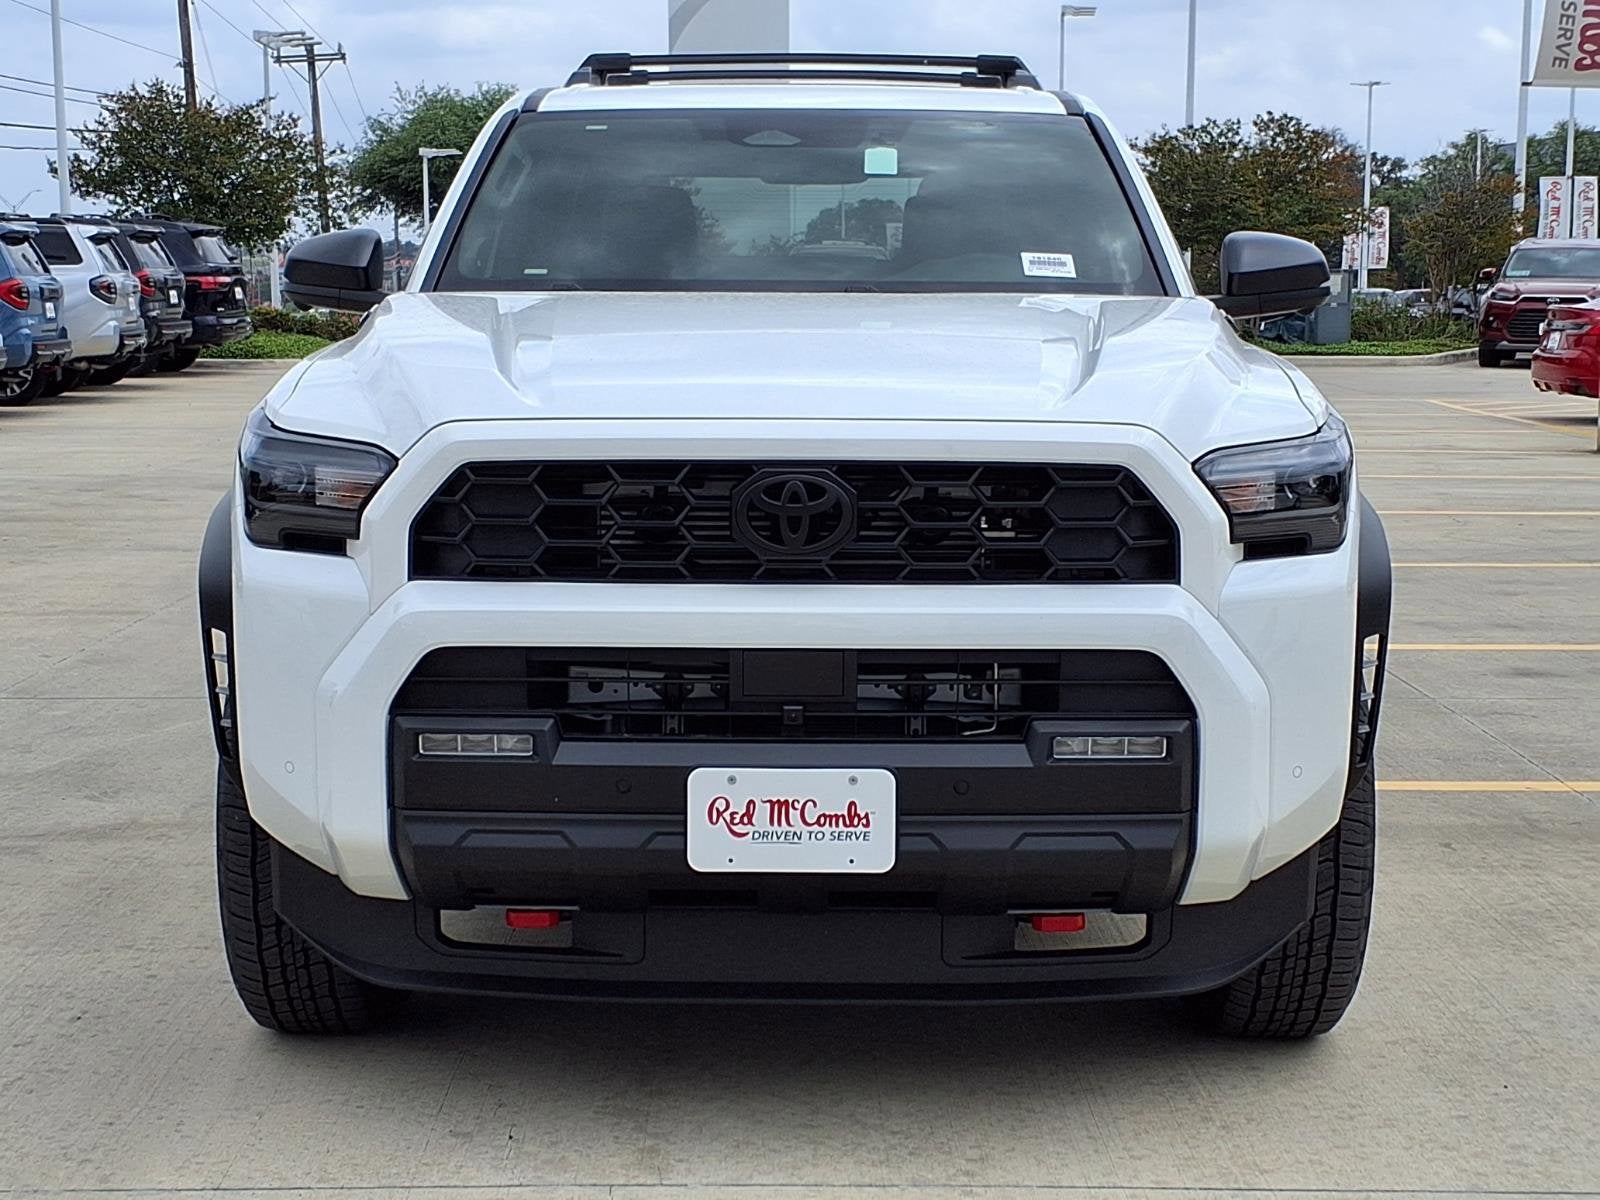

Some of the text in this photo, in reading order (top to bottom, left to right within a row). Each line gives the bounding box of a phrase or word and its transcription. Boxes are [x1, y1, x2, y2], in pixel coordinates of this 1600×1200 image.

[1551, 0, 1577, 69] SERVE
[1546, 181, 1562, 239] Red McCom
[1578, 181, 1595, 201] Red
[1581, 203, 1595, 239] McCom
[707, 796, 871, 838] Red McCombs
[751, 830, 871, 842] DRIVEN TO SERVE
